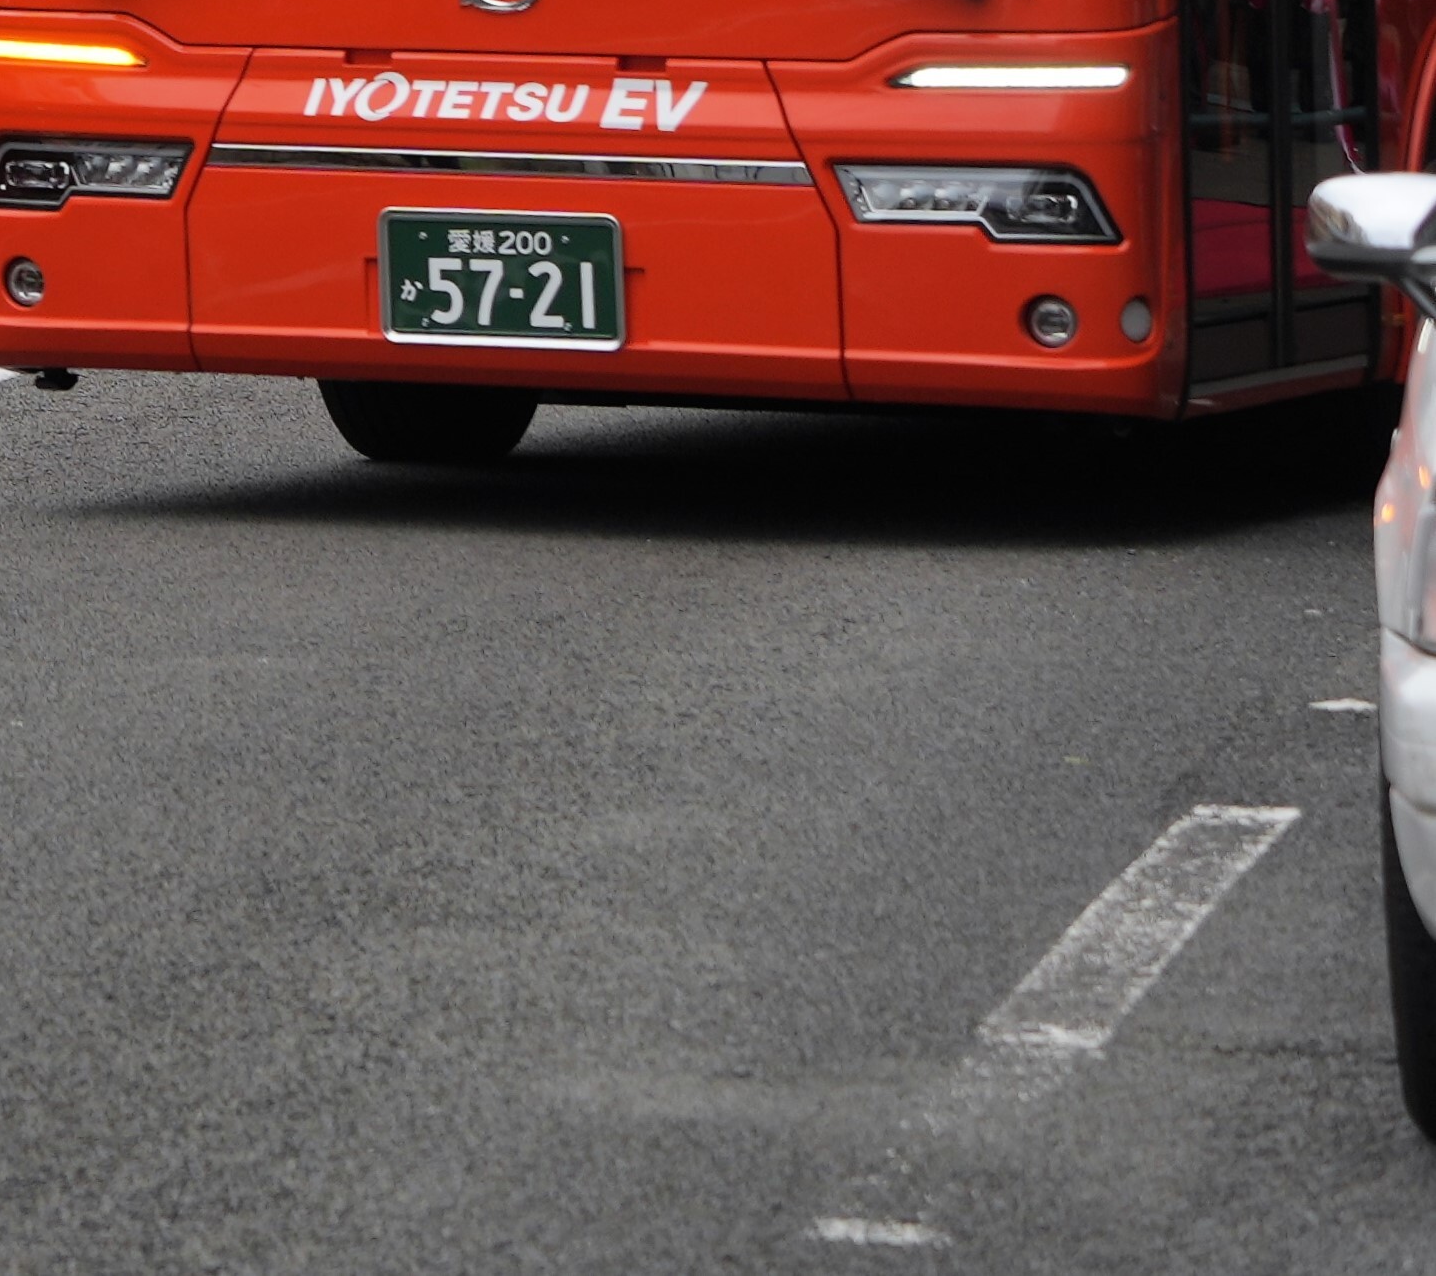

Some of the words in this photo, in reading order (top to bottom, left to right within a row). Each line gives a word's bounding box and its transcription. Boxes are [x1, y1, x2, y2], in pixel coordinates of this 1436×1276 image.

[303, 71, 590, 122] IYOTETSU
[599, 77, 709, 132] EV
[400, 276, 424, 302] か
[428, 257, 597, 330] 57-21
